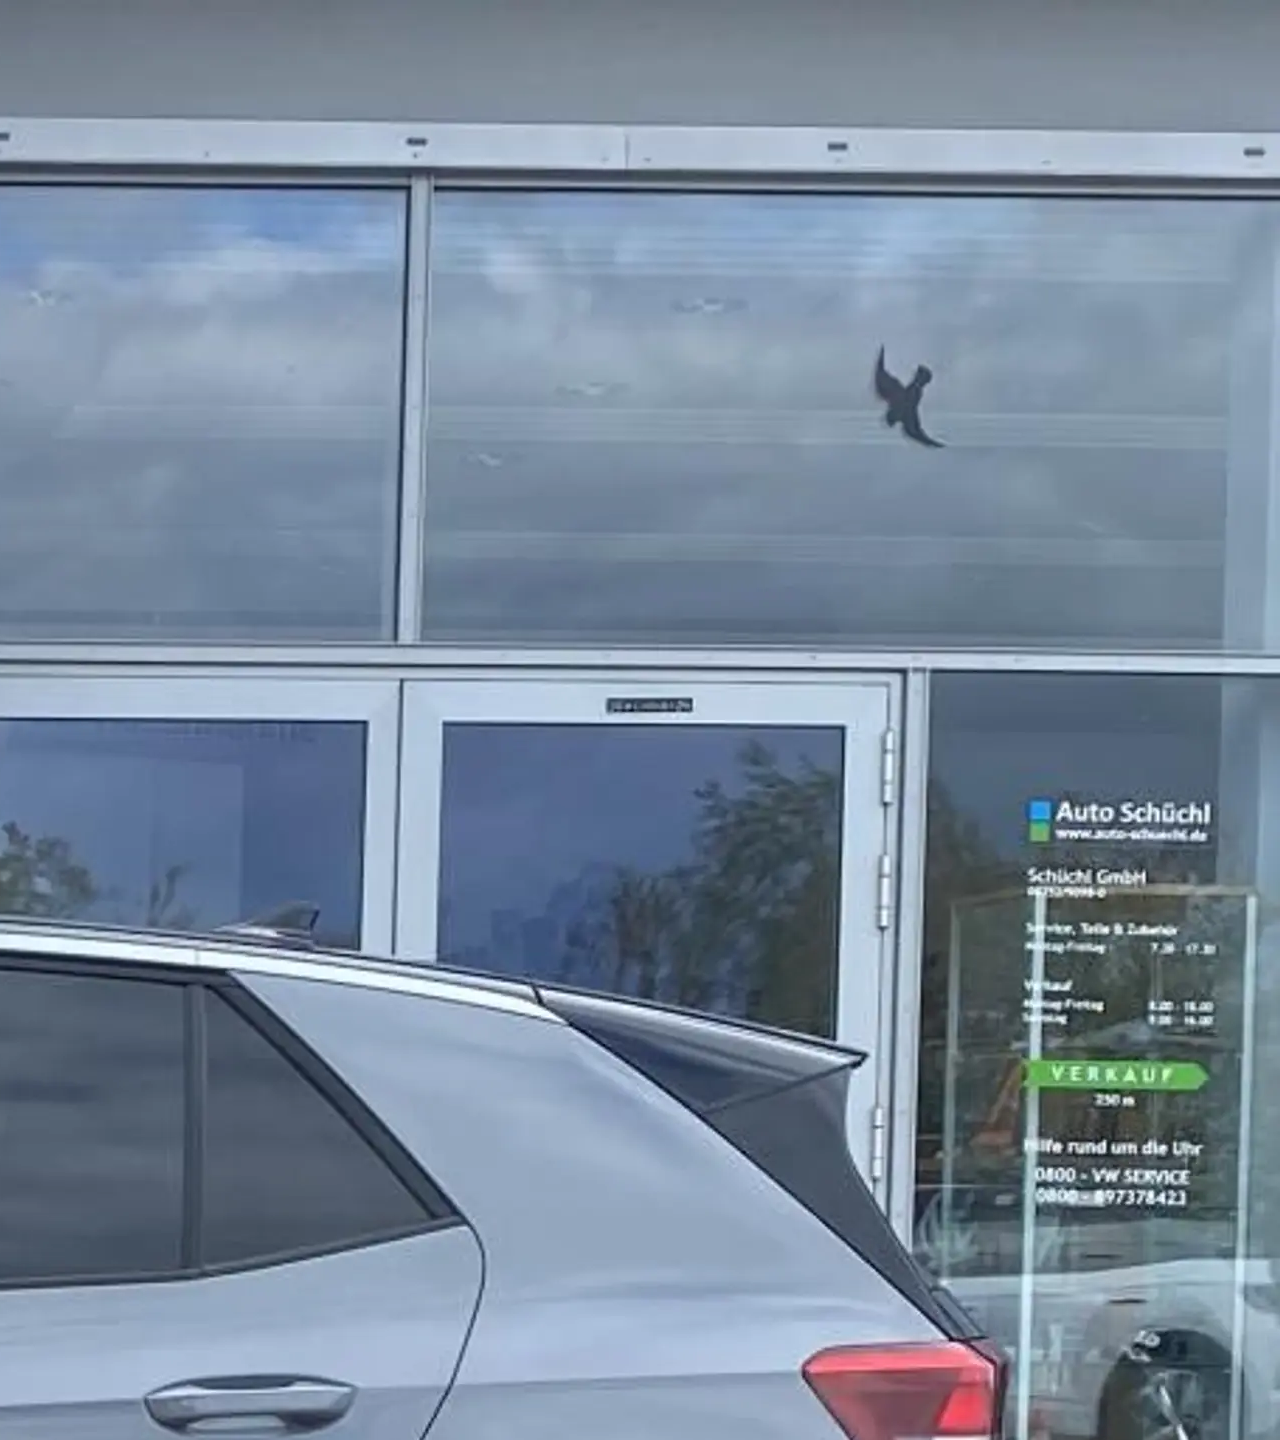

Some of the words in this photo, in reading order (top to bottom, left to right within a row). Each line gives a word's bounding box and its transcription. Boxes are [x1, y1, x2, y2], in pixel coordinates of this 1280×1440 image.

[1055, 801, 1115, 823] Auto
[1119, 801, 1211, 824] Schüchl
[1026, 867, 1092, 884] Schüchl
[1096, 868, 1147, 887] GmbH
[1051, 1066, 1174, 1084] VERKAUF
[1068, 1140, 1107, 1155] rund
[1110, 1142, 1138, 1156] um
[1141, 1140, 1168, 1156] die
[1172, 1141, 1203, 1157] Uhr
[1035, 1167, 1076, 1182] 0800
[1092, 1168, 1122, 1184] VW
[1123, 1169, 1192, 1186] SERVICE
